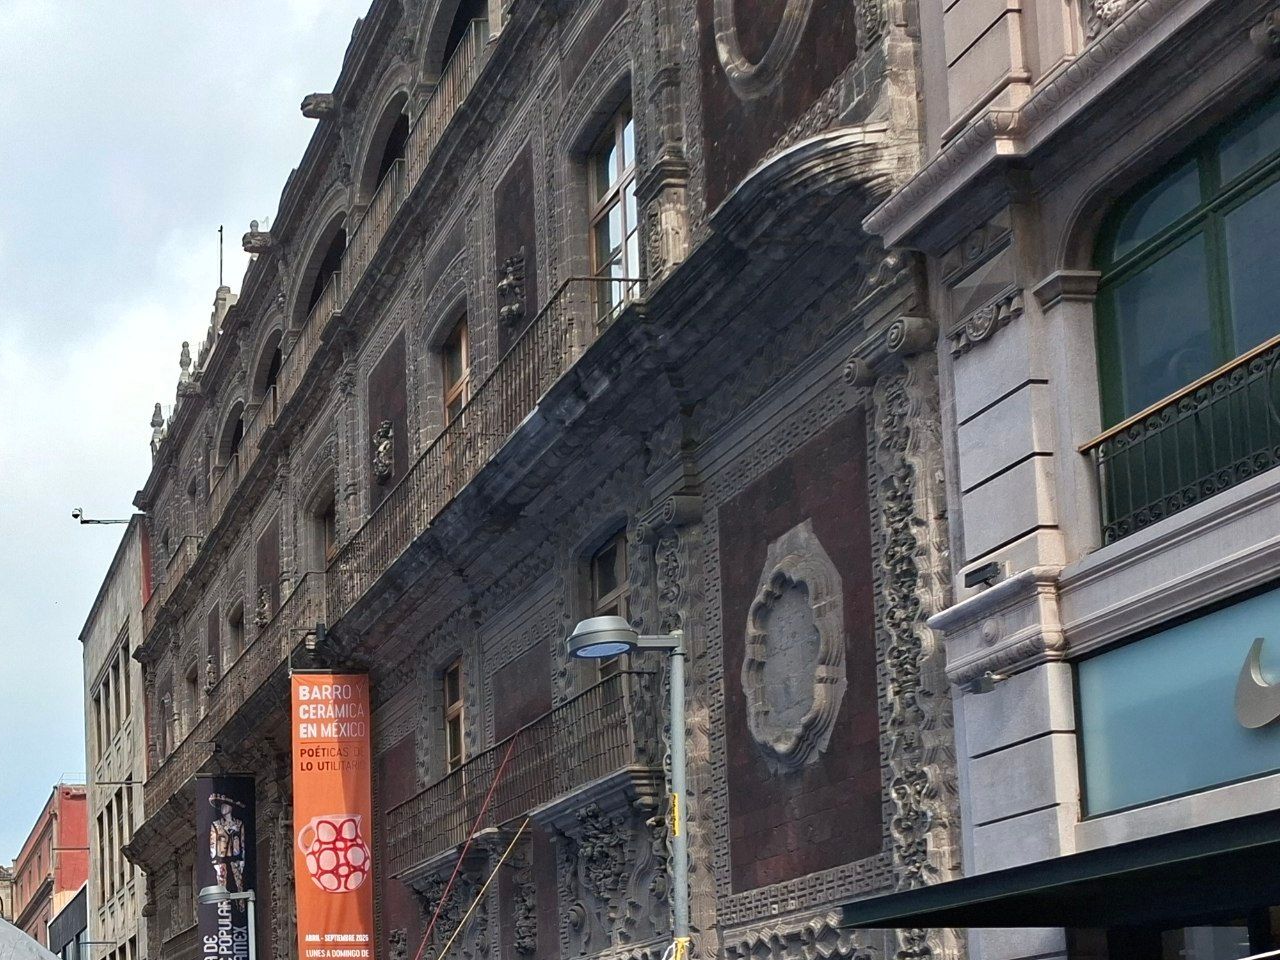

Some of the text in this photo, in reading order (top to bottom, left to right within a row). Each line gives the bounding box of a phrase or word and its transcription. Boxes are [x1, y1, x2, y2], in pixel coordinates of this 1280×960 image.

[298, 682, 366, 700] BARRO Y
[299, 699, 365, 719] CERÁMICA
[299, 718, 365, 738] EN MÉXICO
[300, 745, 349, 758] POÉTICAS
[300, 761, 313, 771] LO
[218, 899, 233, 955] POPULAR
[305, 934, 320, 942] ABRIL
[324, 934, 355, 942] SEPTIEMBRE
[306, 949, 370, 957] LUNES A DOMINGO DE
